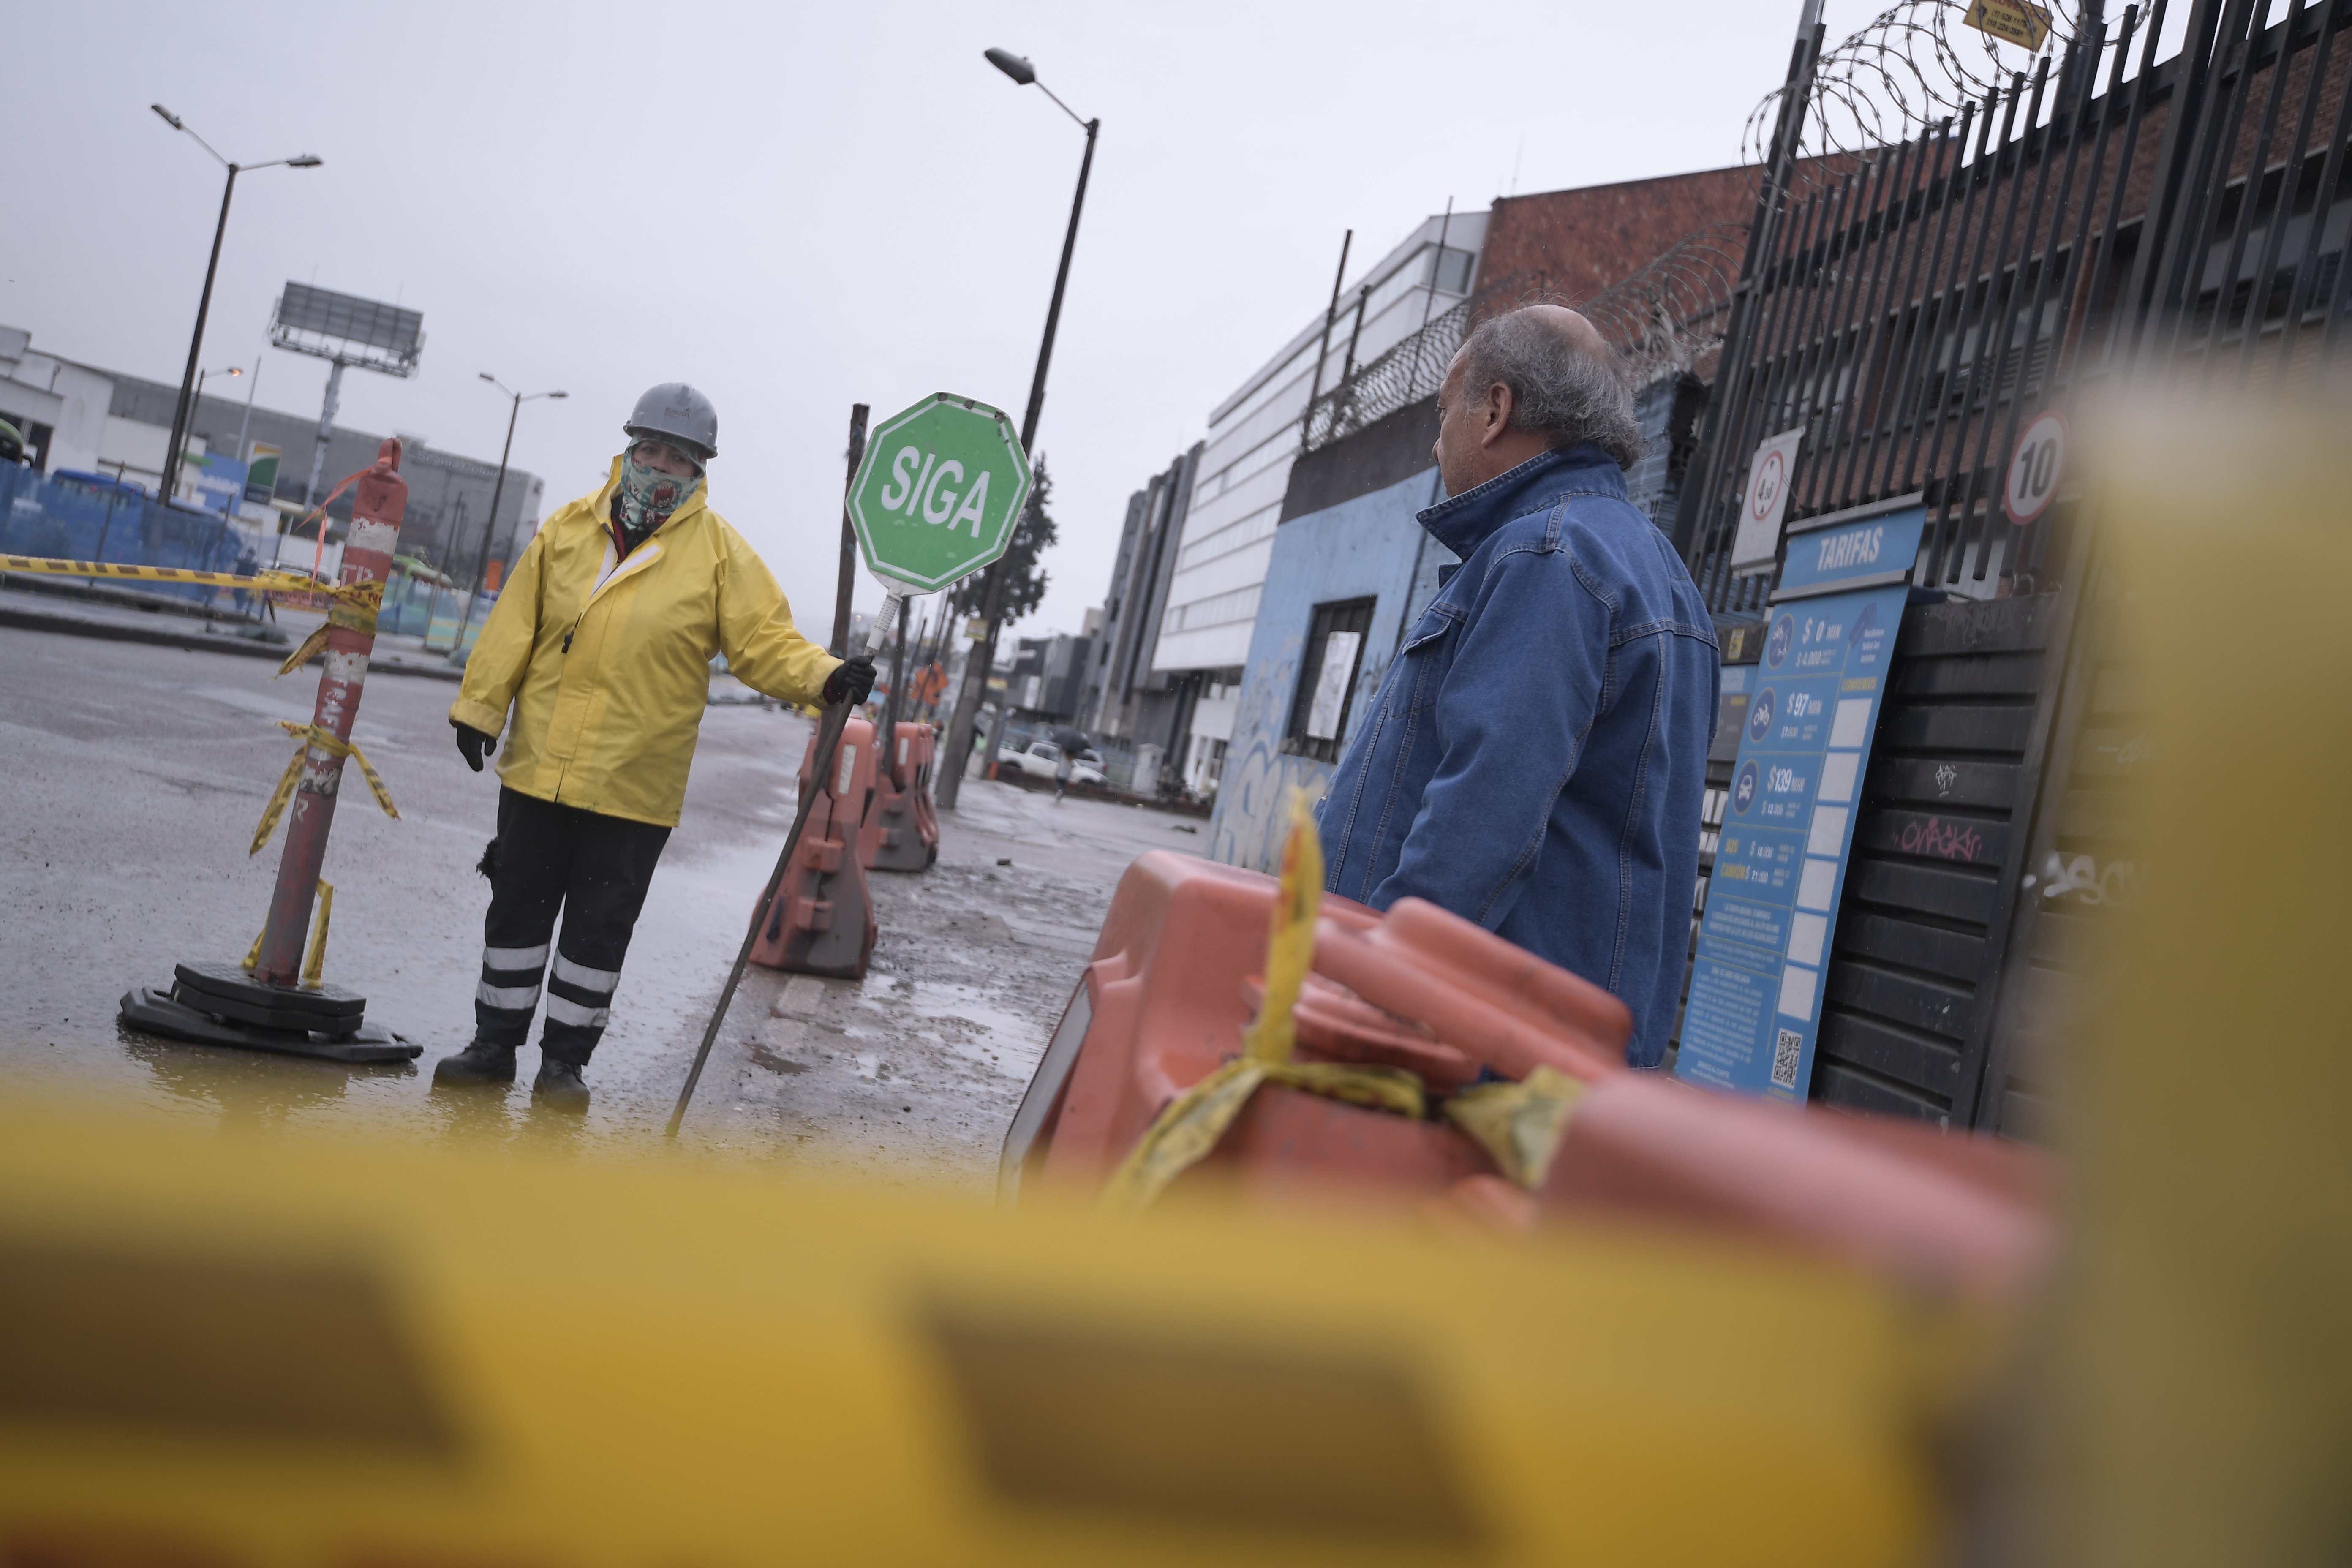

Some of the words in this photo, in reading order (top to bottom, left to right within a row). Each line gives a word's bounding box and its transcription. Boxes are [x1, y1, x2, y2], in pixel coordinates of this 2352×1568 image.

[2019, 438, 2057, 499] 10
[881, 445, 990, 537] SIGA
[1816, 526, 1883, 571] TARIFAS
[1816, 620, 1824, 642] 0
[1826, 624, 1842, 639] MIN
[1842, 677, 1878, 692] CONVENIOS
[1808, 700, 1822, 714] MIN
[1791, 777, 1805, 792] MIN
